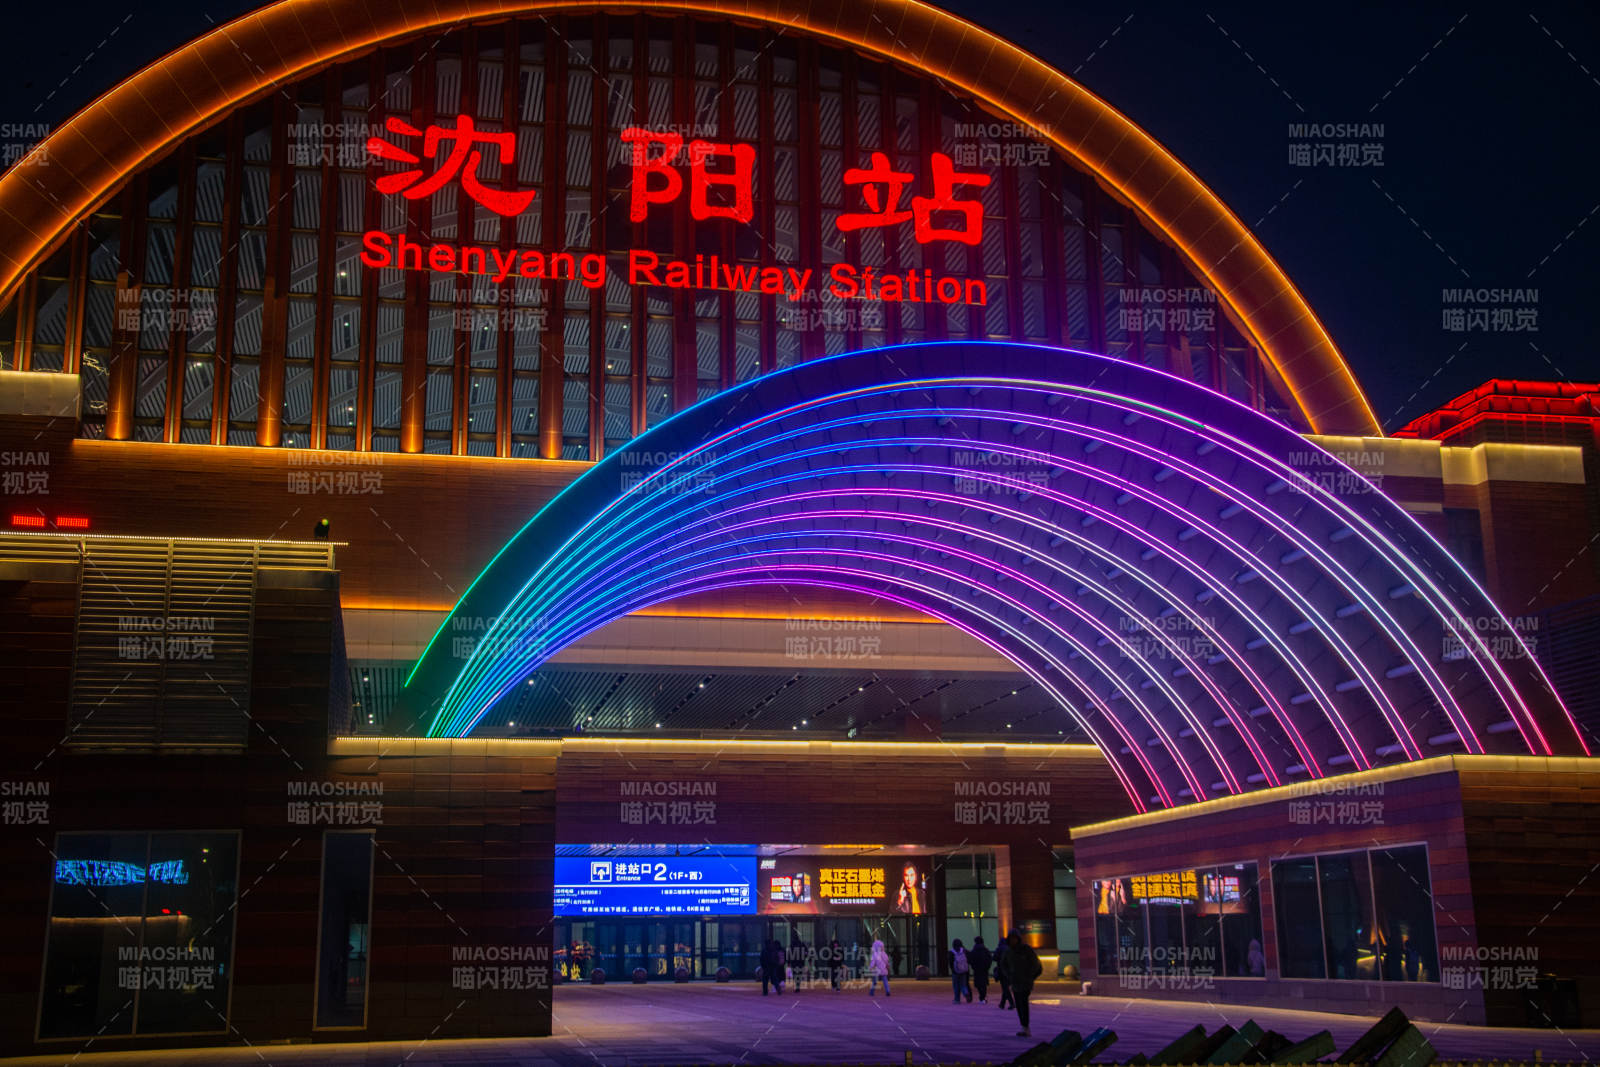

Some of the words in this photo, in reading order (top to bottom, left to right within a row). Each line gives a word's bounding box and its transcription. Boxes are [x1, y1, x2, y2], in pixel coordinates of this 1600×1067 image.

[366, 114, 992, 246] 沈阳站
[360, 230, 606, 289] Shenyang
[629, 249, 813, 302] Railway
[829, 263, 987, 306] Station
[615, 863, 651, 875] 进站口
[654, 862, 667, 881] 2
